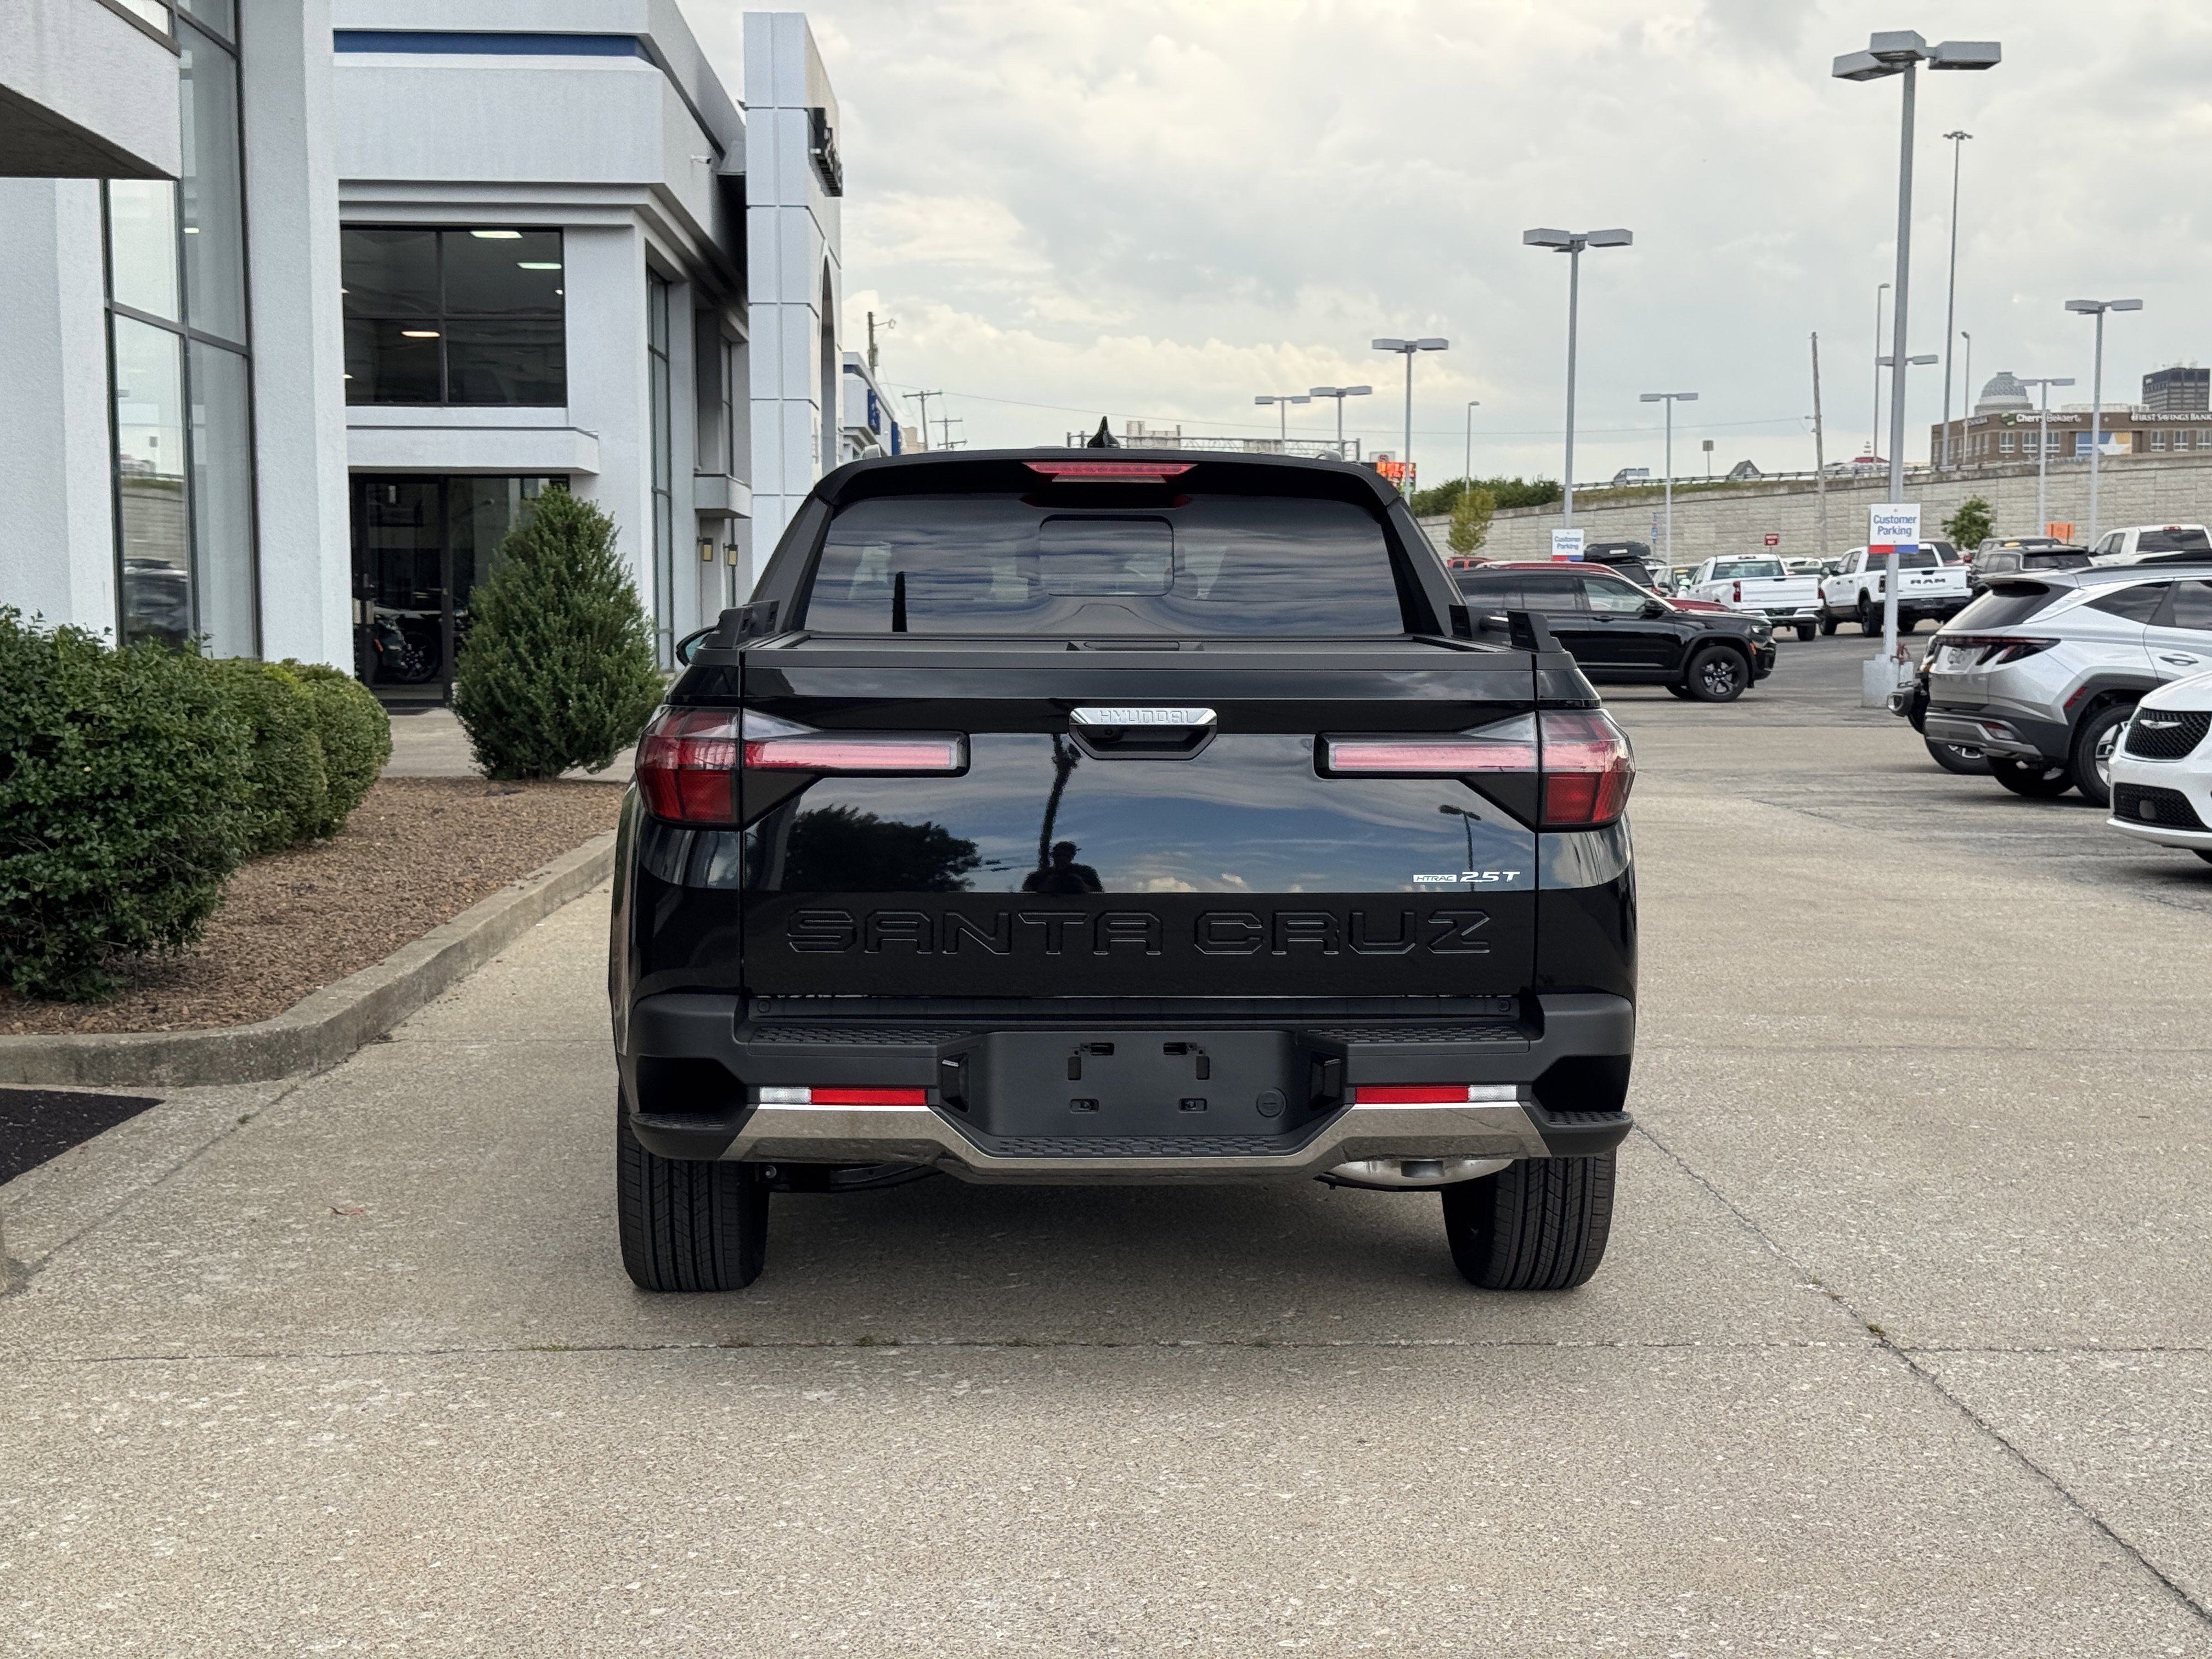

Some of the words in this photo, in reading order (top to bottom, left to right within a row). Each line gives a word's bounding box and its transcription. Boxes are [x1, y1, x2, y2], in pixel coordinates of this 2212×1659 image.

[1874, 515, 1917, 524] Customer
[1877, 525, 1912, 537] Parking
[1099, 709, 1190, 724] HYUNDAI
[787, 910, 1162, 955] SANTA
[1194, 910, 1491, 955] CRUZ
